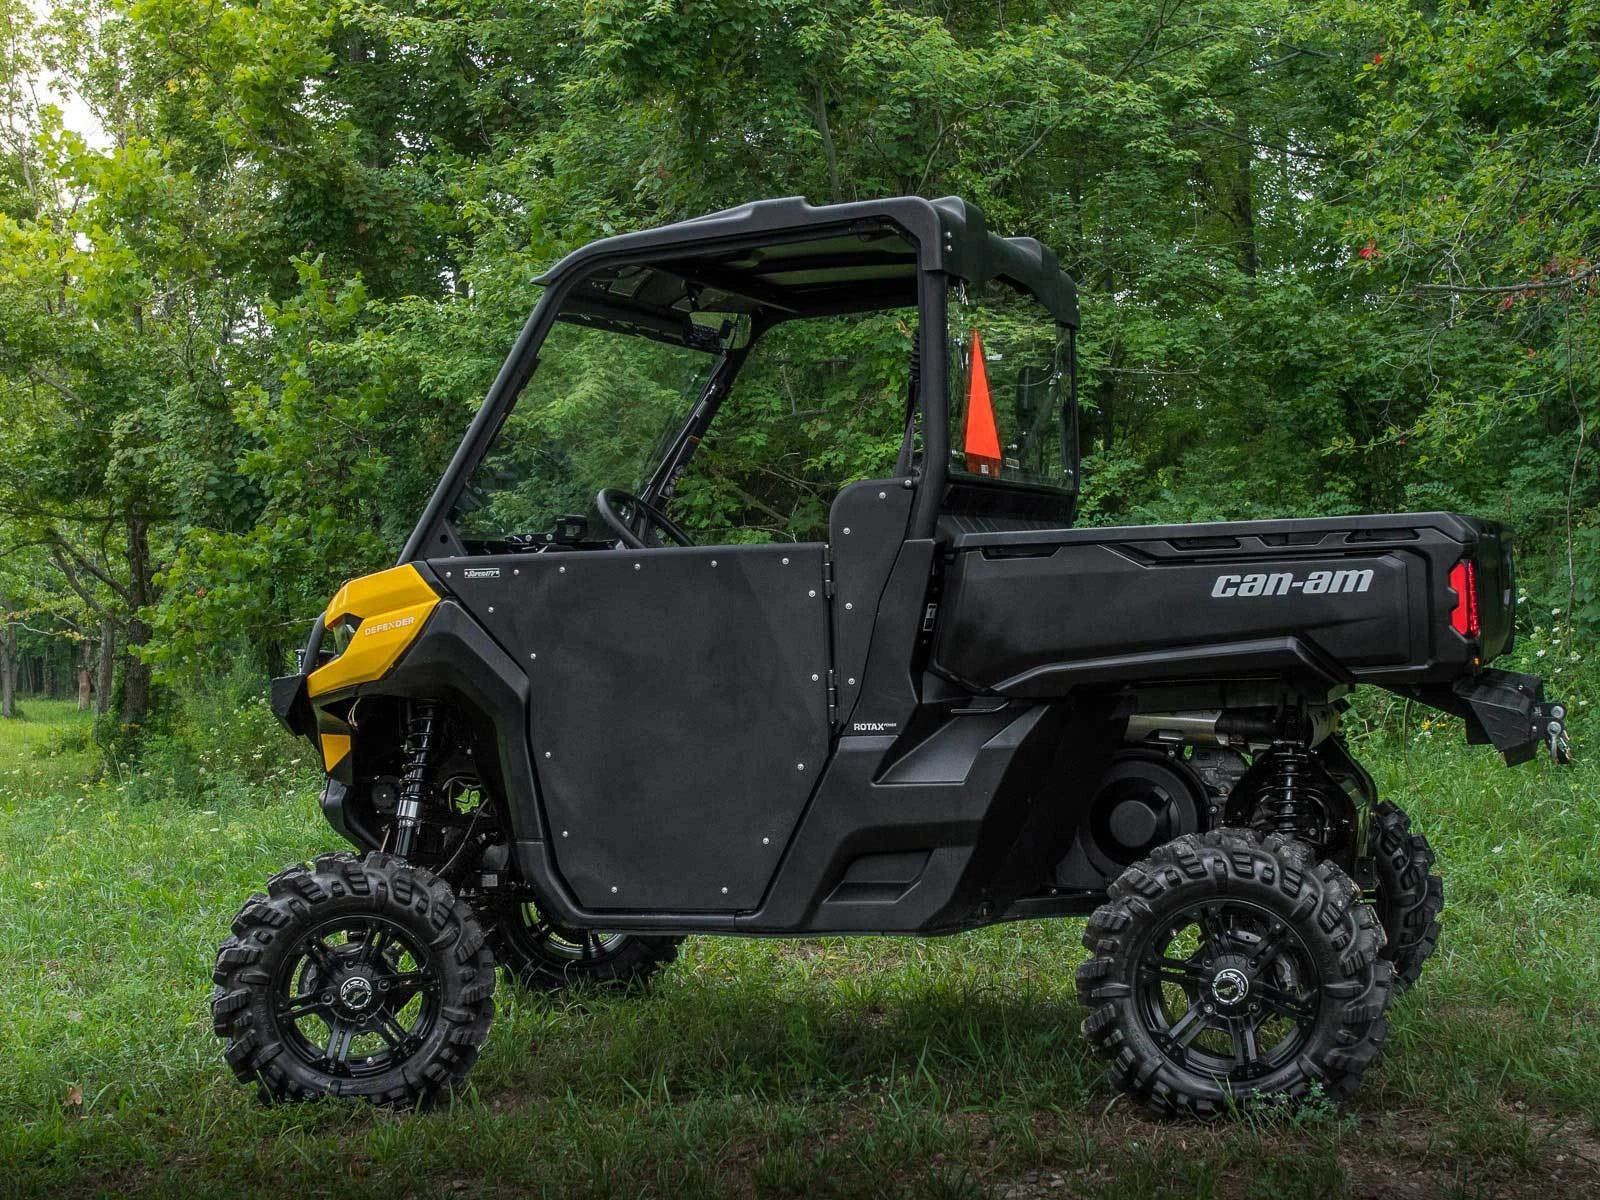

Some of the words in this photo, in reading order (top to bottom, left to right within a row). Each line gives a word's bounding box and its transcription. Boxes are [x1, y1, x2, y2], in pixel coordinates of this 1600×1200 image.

[1211, 569, 1374, 598] can-am
[364, 616, 415, 636] DEFENDER
[853, 722, 884, 731] ROTAX
